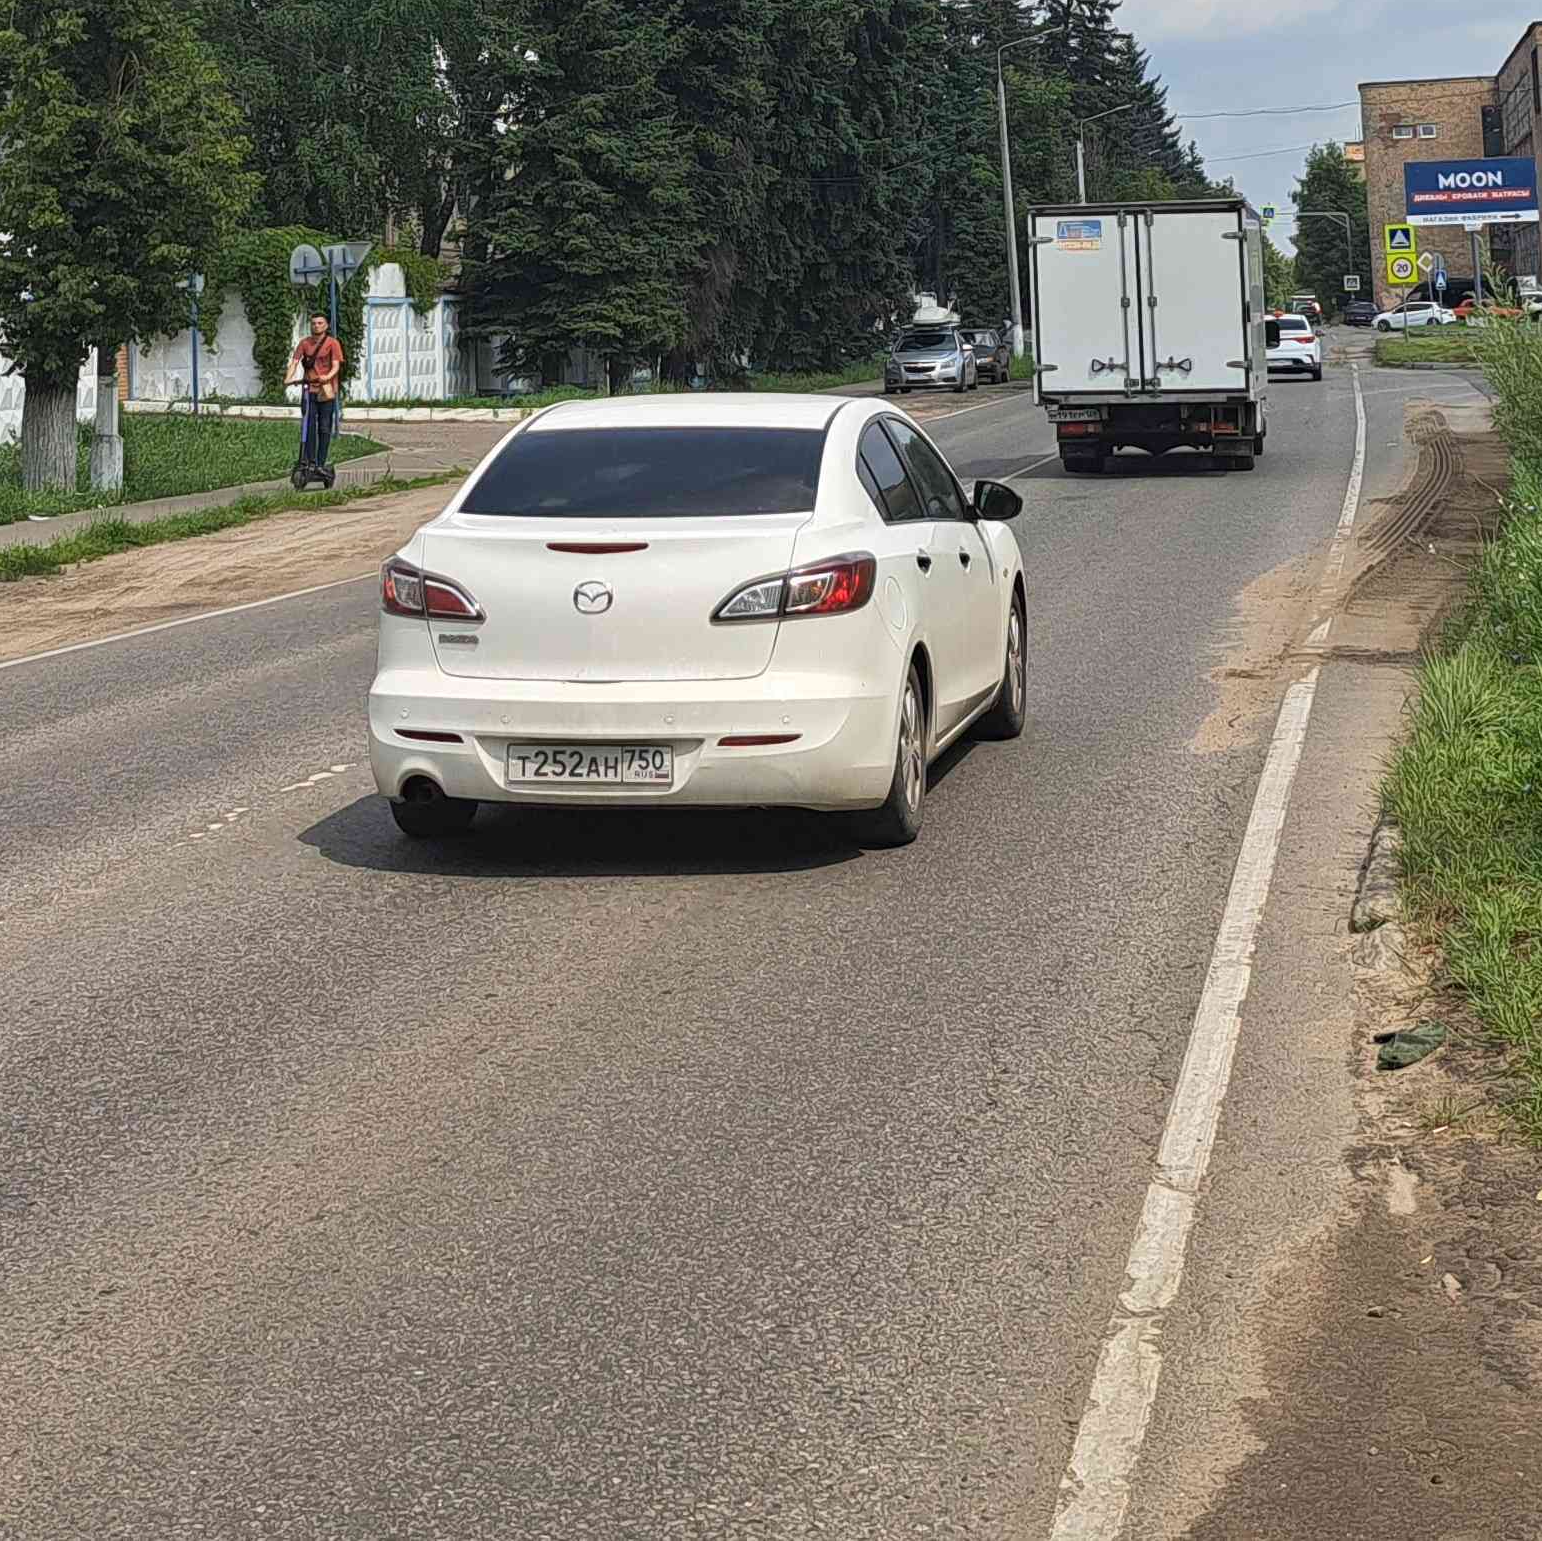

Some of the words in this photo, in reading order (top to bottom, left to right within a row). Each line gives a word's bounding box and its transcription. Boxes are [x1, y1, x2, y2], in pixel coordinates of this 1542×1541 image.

[1437, 171, 1503, 189] MOON
[1395, 263, 1408, 273] 20
[624, 749, 665, 771] 750
